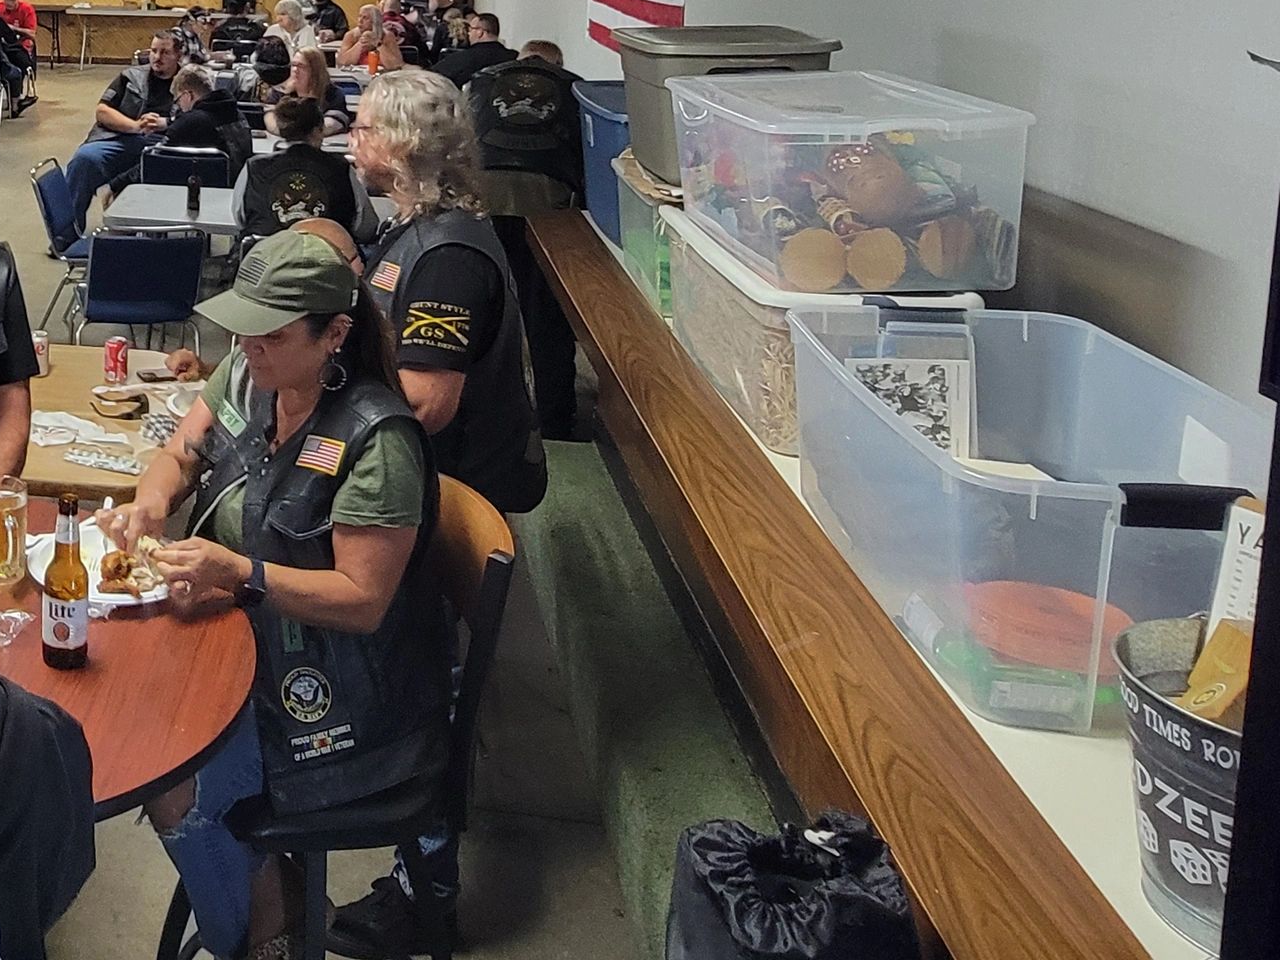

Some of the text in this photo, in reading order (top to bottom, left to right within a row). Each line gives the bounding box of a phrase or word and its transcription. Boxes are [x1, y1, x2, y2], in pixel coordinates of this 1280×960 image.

[420, 326, 445, 339] GS
[49, 601, 75, 621] Lite
[1142, 703, 1191, 751] TIMES
